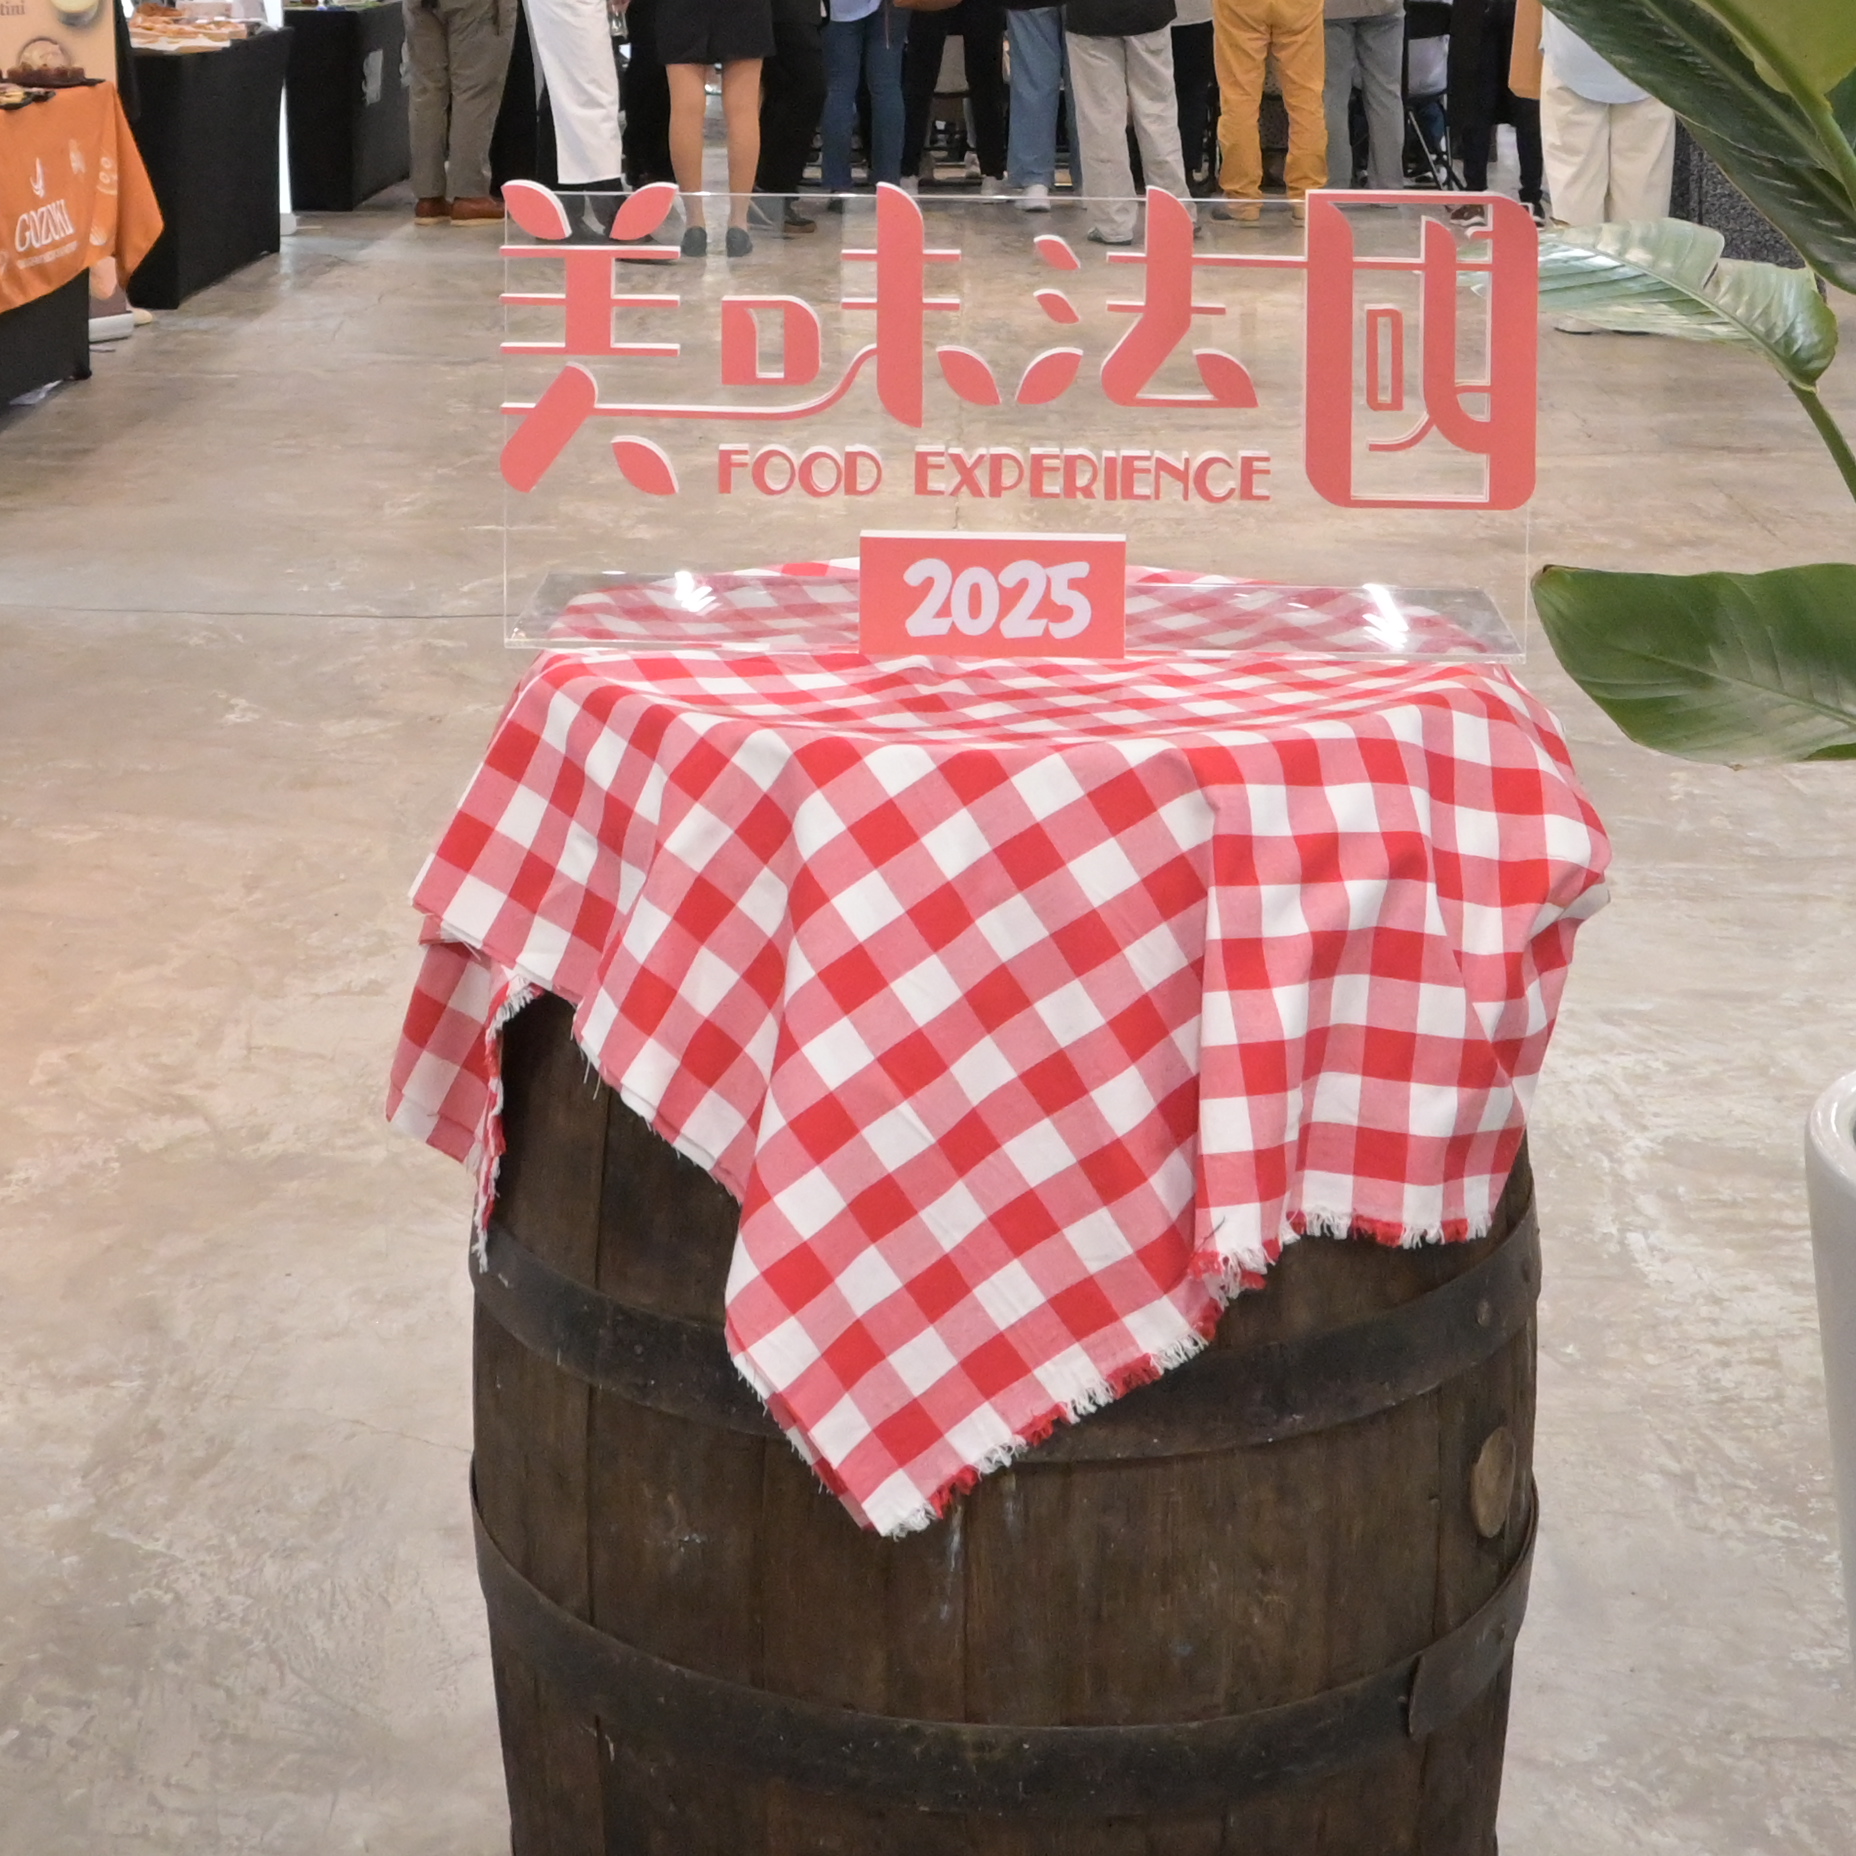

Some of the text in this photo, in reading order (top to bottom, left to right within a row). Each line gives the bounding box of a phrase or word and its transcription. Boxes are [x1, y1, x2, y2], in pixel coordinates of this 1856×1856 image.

[716, 443, 1273, 504] FOOD EXPERIENCE
[902, 557, 1092, 641] 2025
